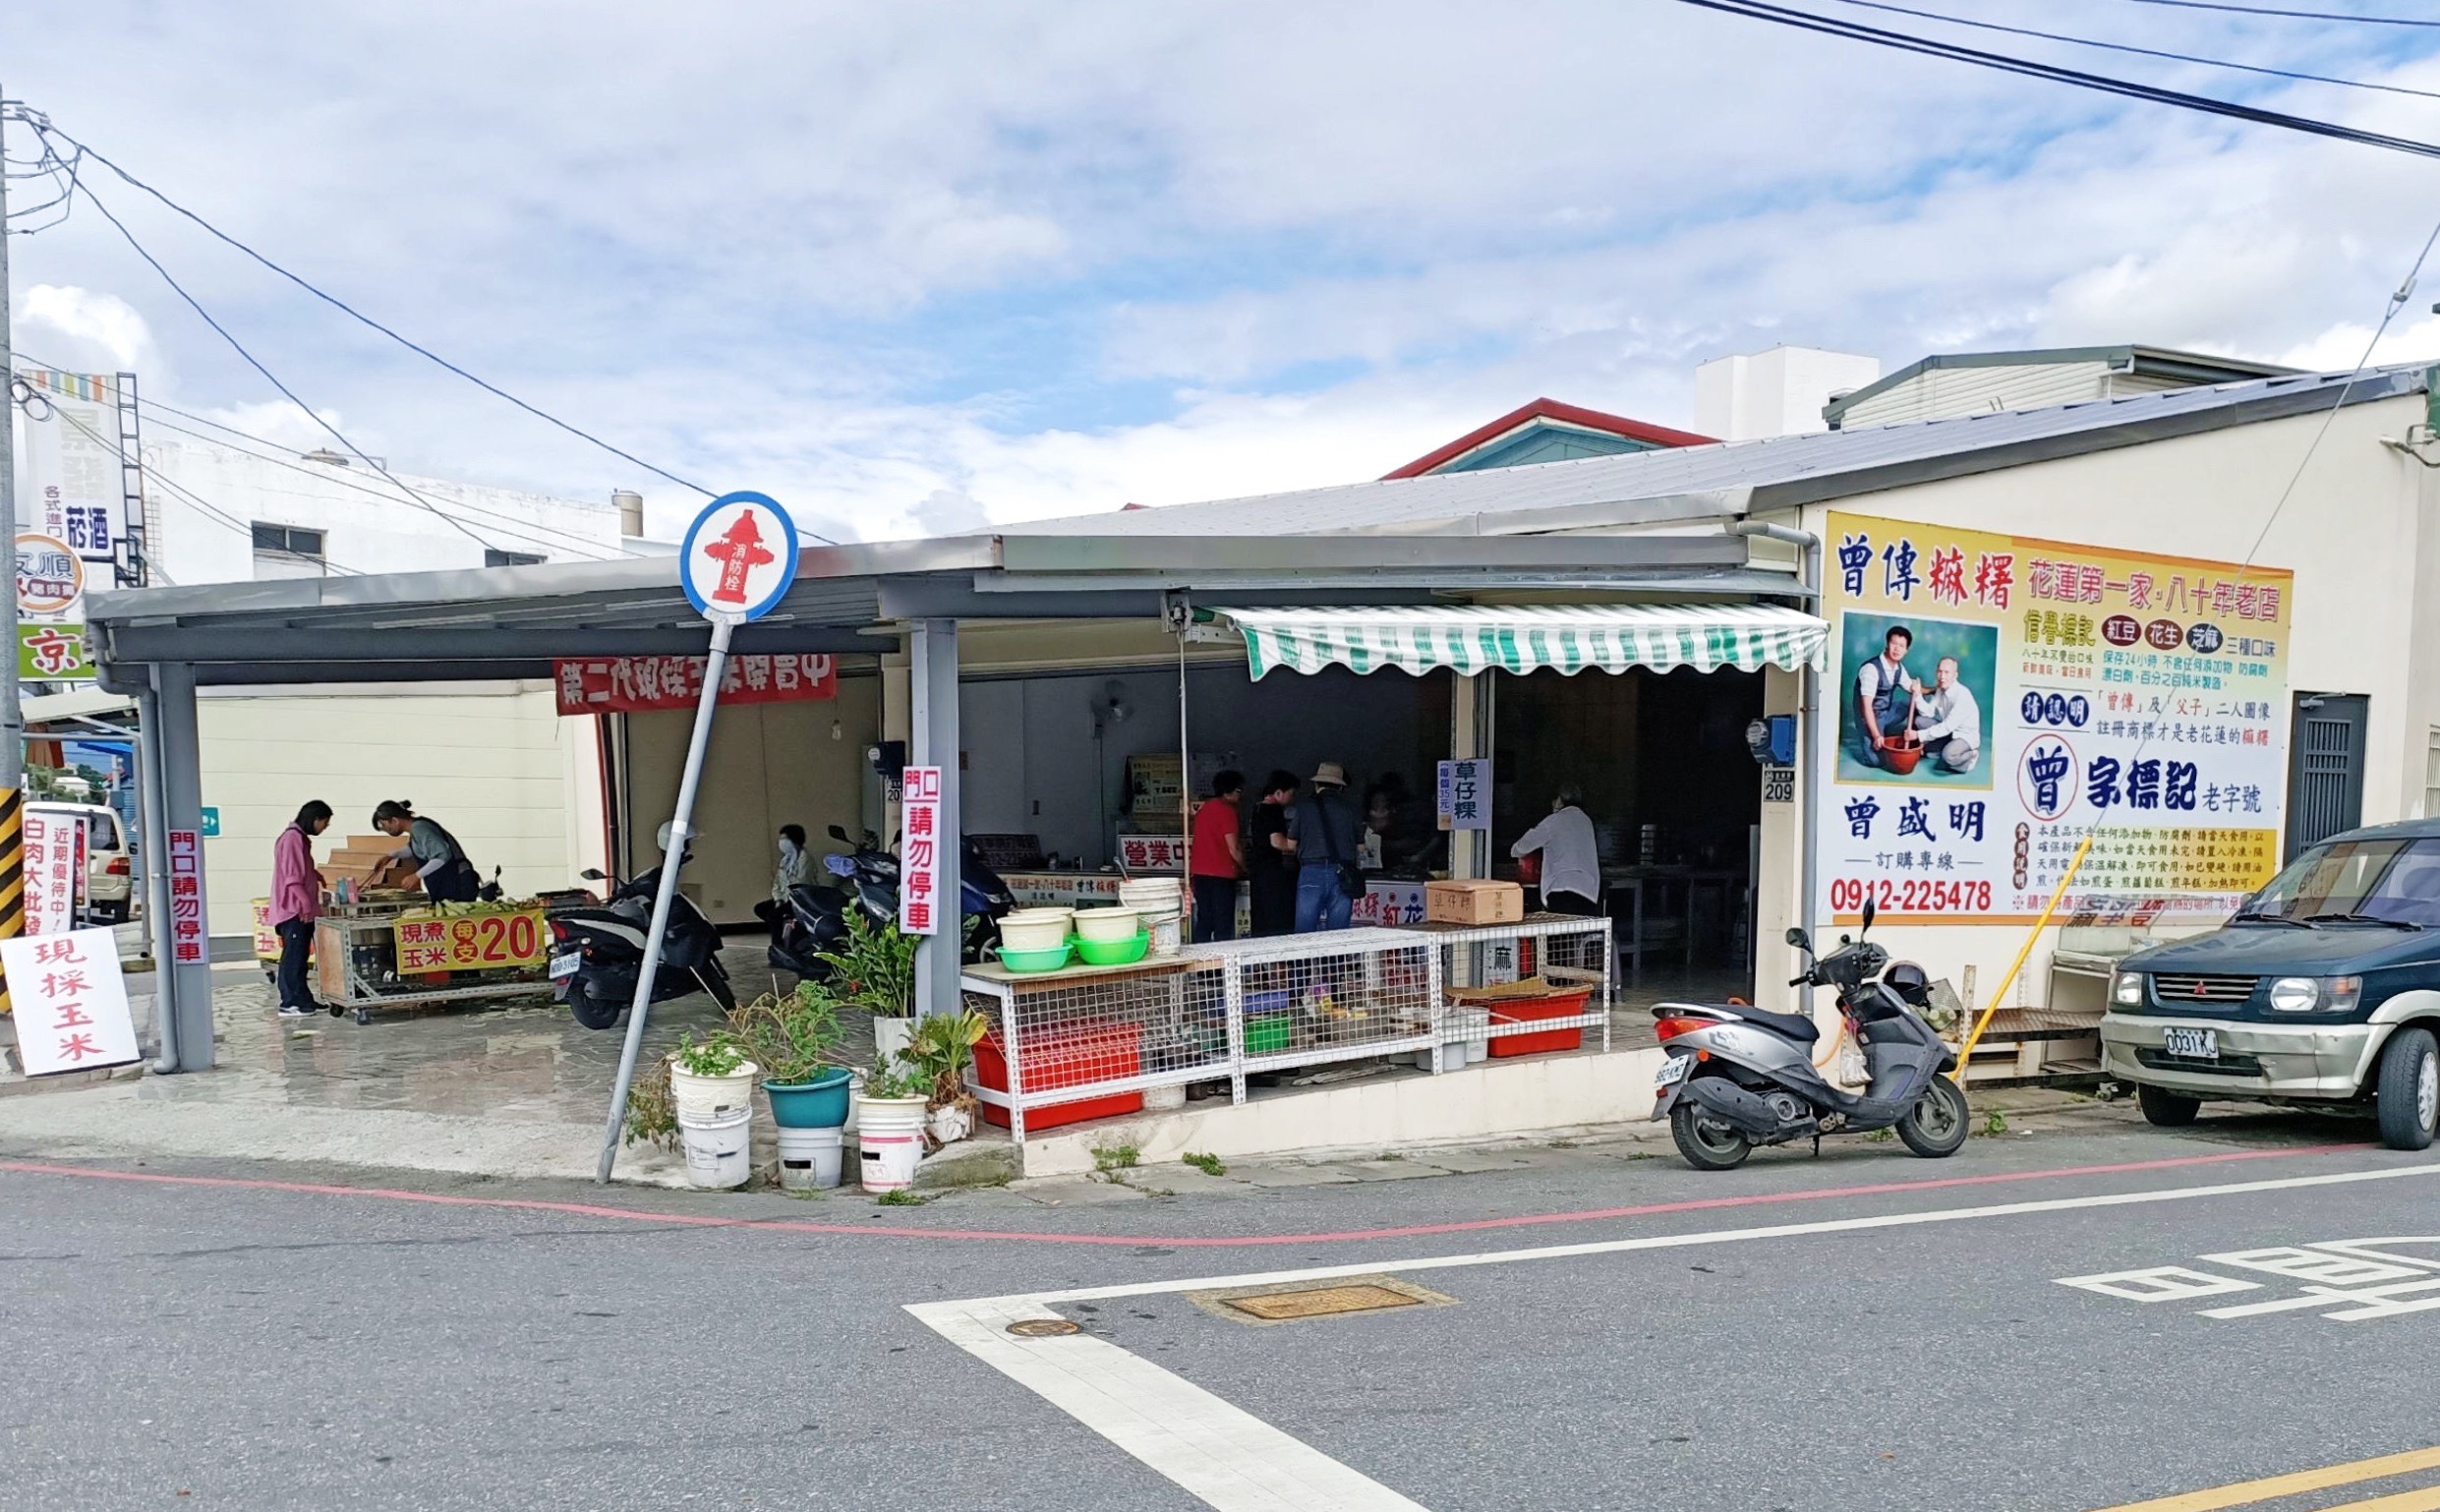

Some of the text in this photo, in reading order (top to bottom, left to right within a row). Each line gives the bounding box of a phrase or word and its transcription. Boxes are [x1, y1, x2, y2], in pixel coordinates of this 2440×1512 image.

[66, 506, 109, 550] 菸酒
[724, 542, 748, 591] 消防栓
[2023, 609, 2097, 647] 信譽標記
[2107, 622, 2277, 659] 紅豆 花生 芝麻 三種口味
[903, 770, 939, 797] 門口
[1454, 762, 1478, 820] 草仔粿
[1765, 784, 1793, 800] 209
[1844, 795, 1986, 843] 曾盛明
[906, 806, 934, 929] 請勿停車
[1875, 849, 1955, 872] 訂購專線
[169, 832, 202, 960] 門口請勿停車
[1830, 878, 1992, 911] 0912-225478
[401, 922, 445, 944] 現煮
[481, 915, 536, 961] 20
[402, 947, 447, 968] 玉米
[34, 938, 106, 1062] 現採玉米
[2166, 1033, 2217, 1055] 0031-KJ
